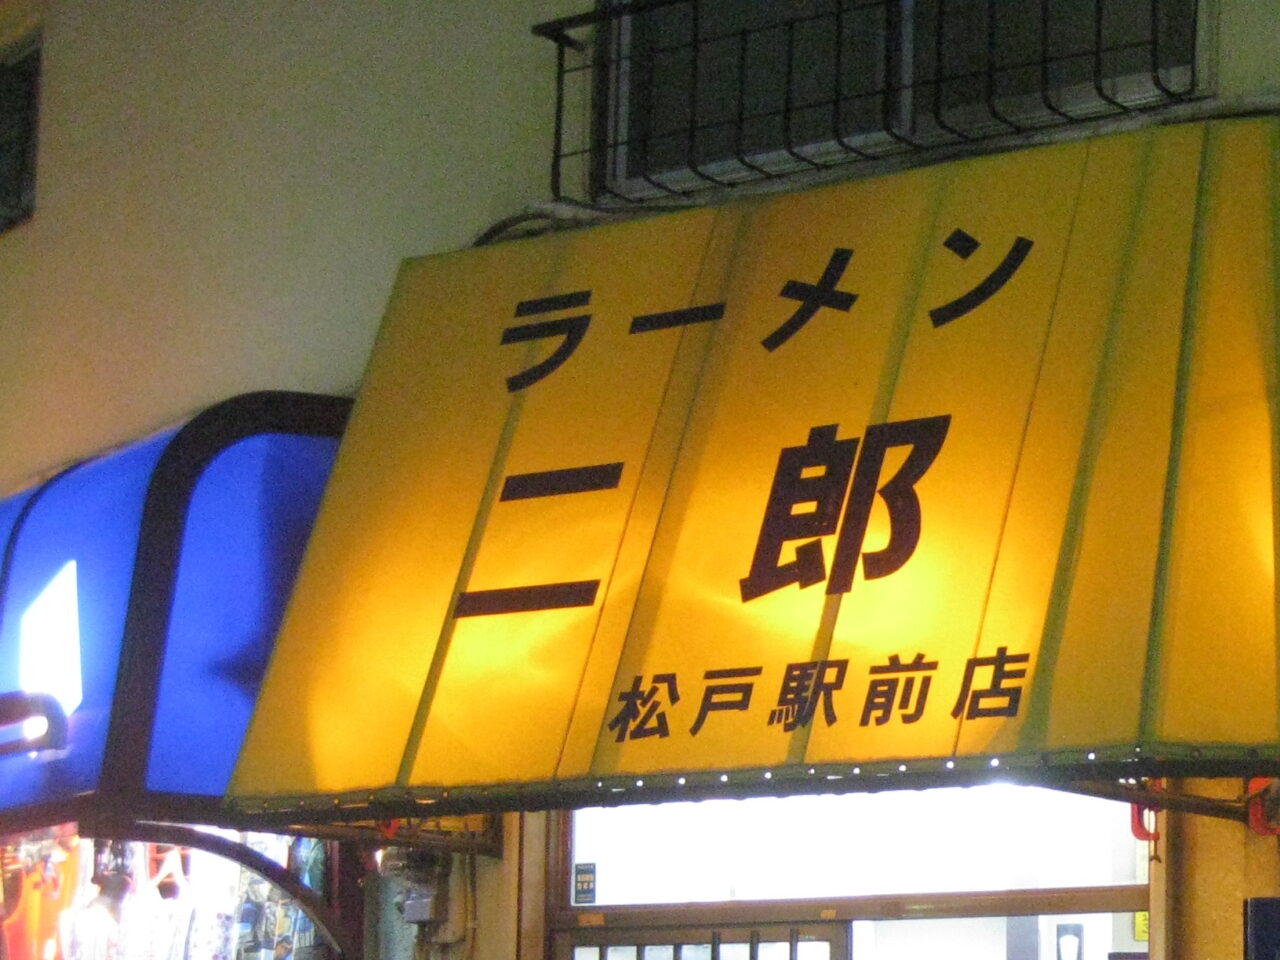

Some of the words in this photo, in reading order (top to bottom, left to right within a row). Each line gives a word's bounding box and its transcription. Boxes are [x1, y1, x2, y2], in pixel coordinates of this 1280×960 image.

[500, 228, 1034, 393] ラーメン
[453, 413, 952, 619] 二郎
[607, 646, 1031, 743] 松戸駅前店
